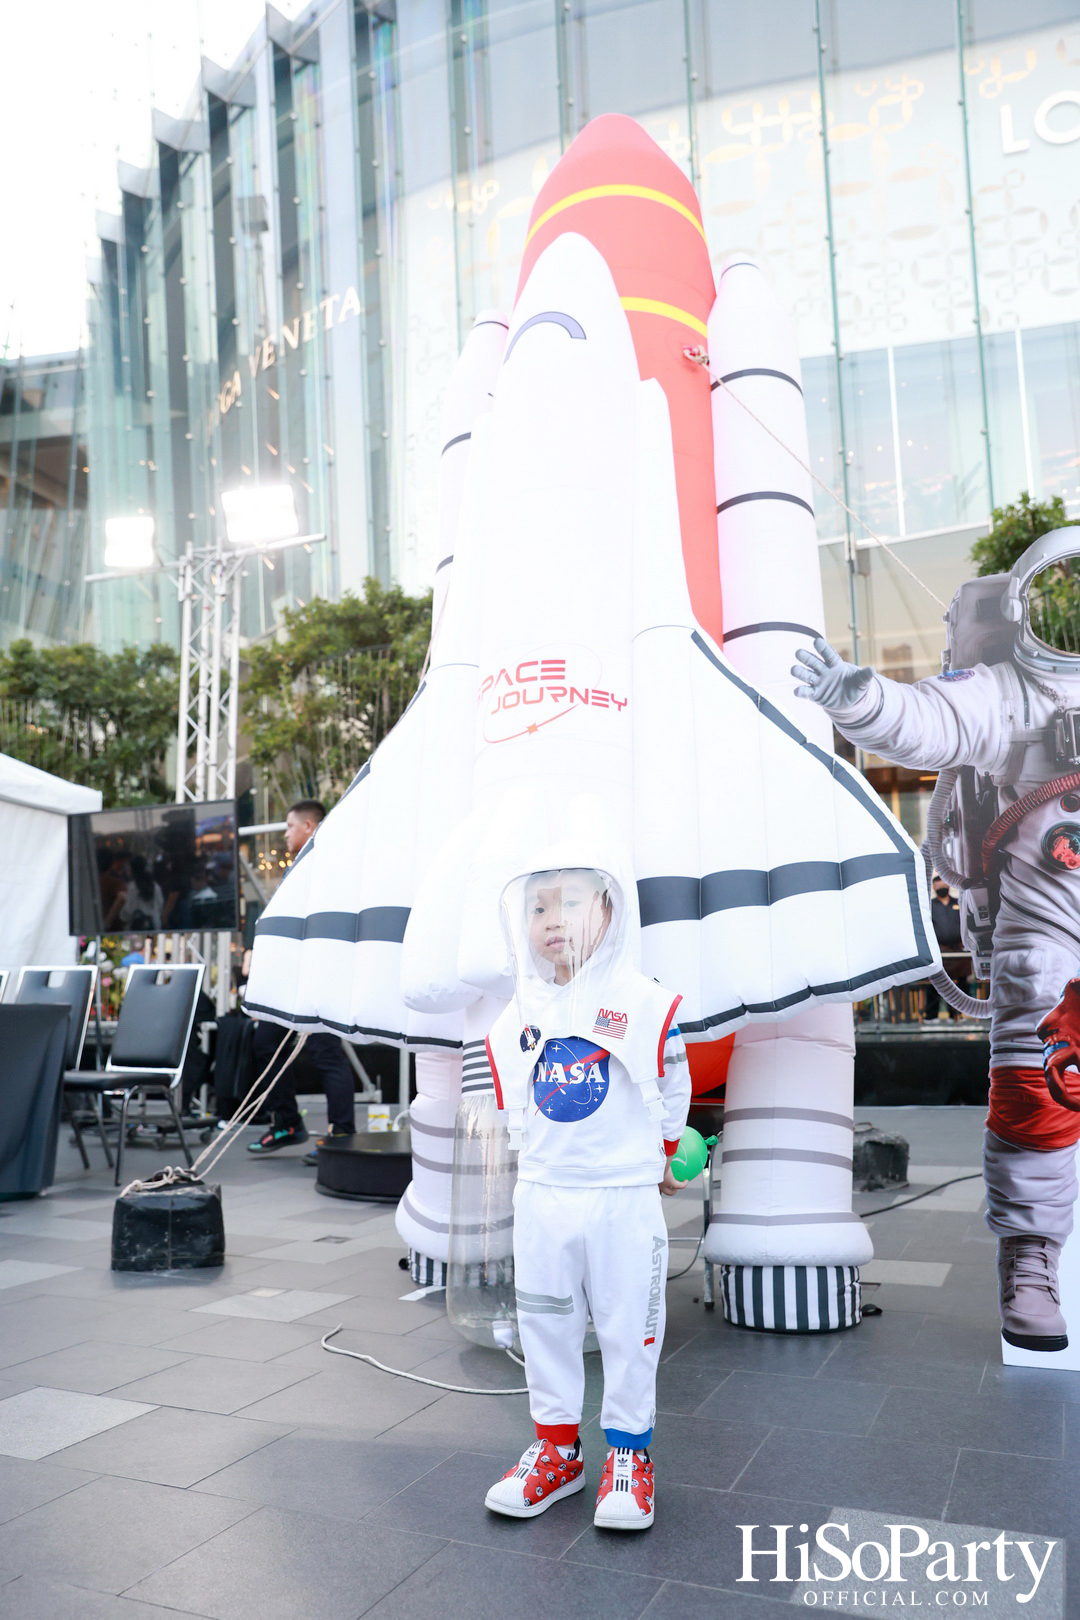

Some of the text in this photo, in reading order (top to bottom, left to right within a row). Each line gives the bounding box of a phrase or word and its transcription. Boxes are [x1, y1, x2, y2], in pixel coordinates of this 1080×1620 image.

[248, 286, 361, 378] VENETA
[478, 659, 566, 704] PACE
[491, 686, 628, 715] JOURNEY
[598, 1008, 628, 1023] NASA
[537, 1062, 606, 1084] NASA
